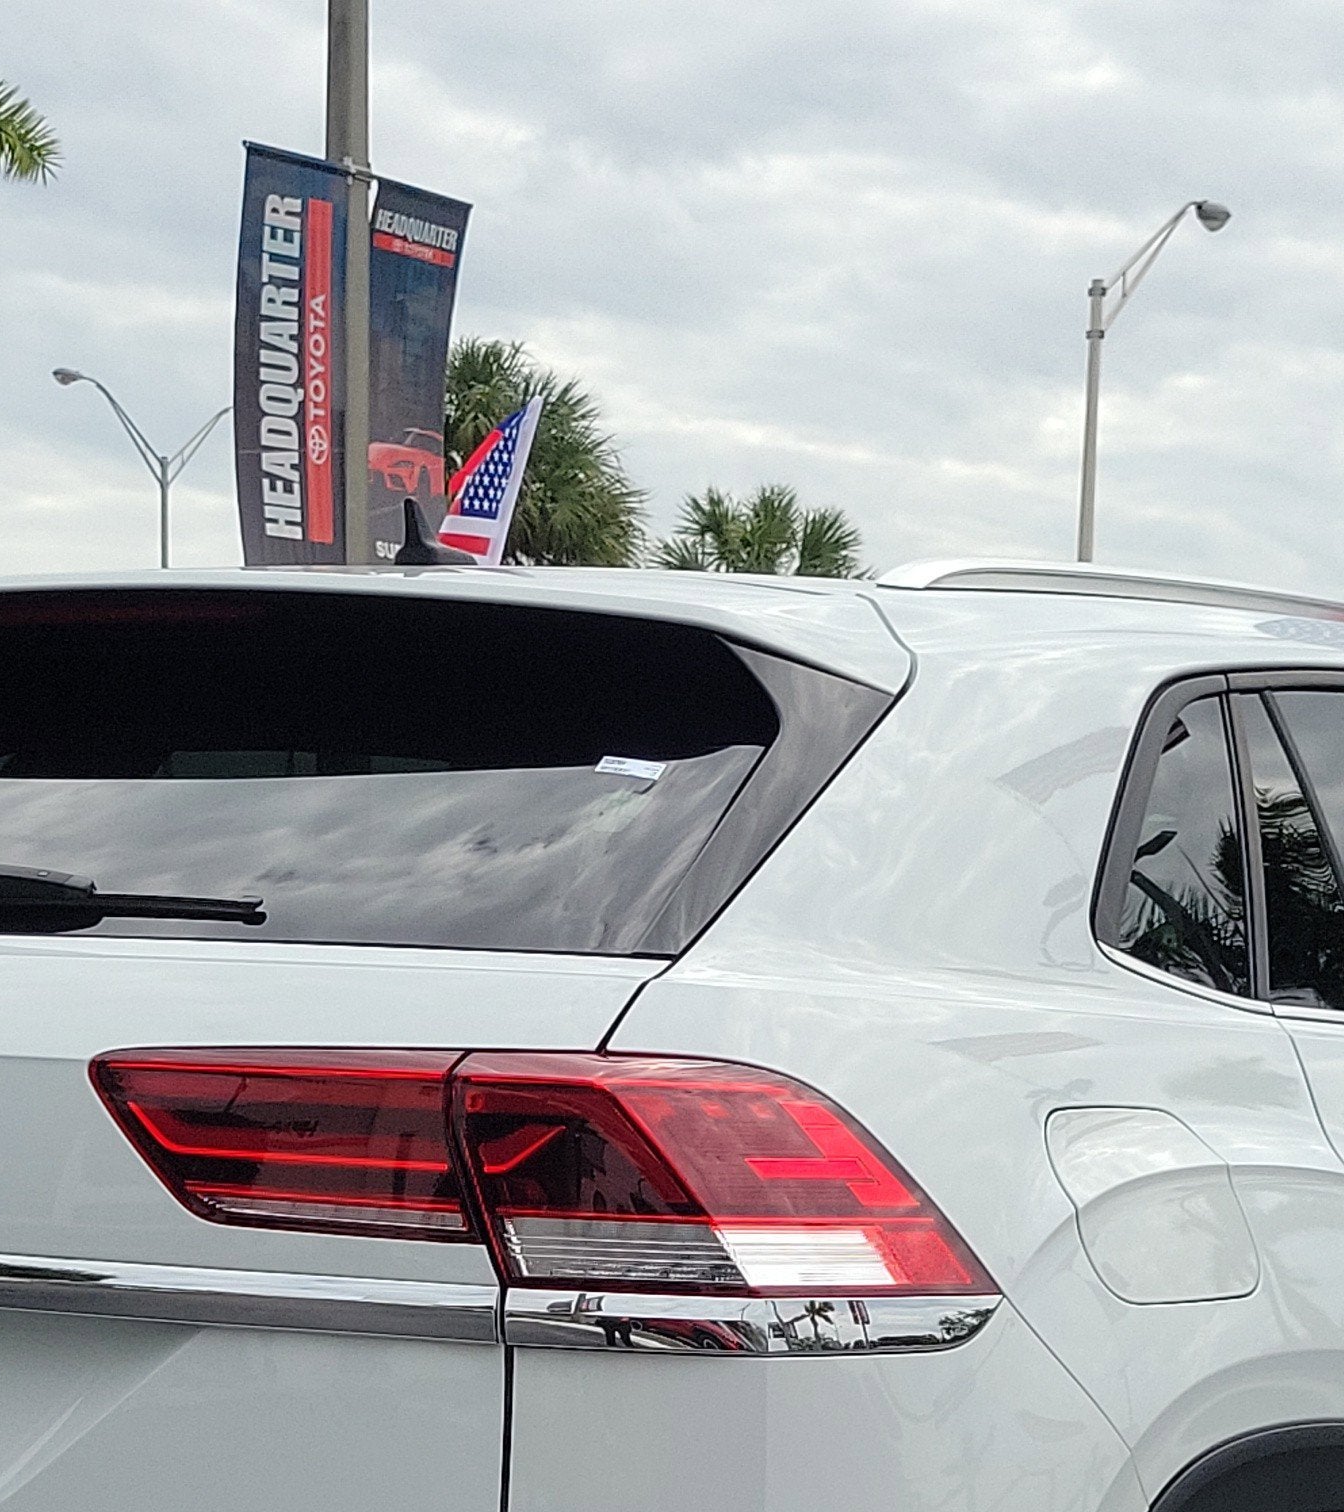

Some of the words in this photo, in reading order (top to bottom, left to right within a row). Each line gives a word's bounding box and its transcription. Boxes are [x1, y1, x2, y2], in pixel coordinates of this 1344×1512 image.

[376, 208, 458, 251] HEADQUARTER
[259, 193, 304, 541] HEADQUARTER
[308, 294, 327, 419] TOYOTA
